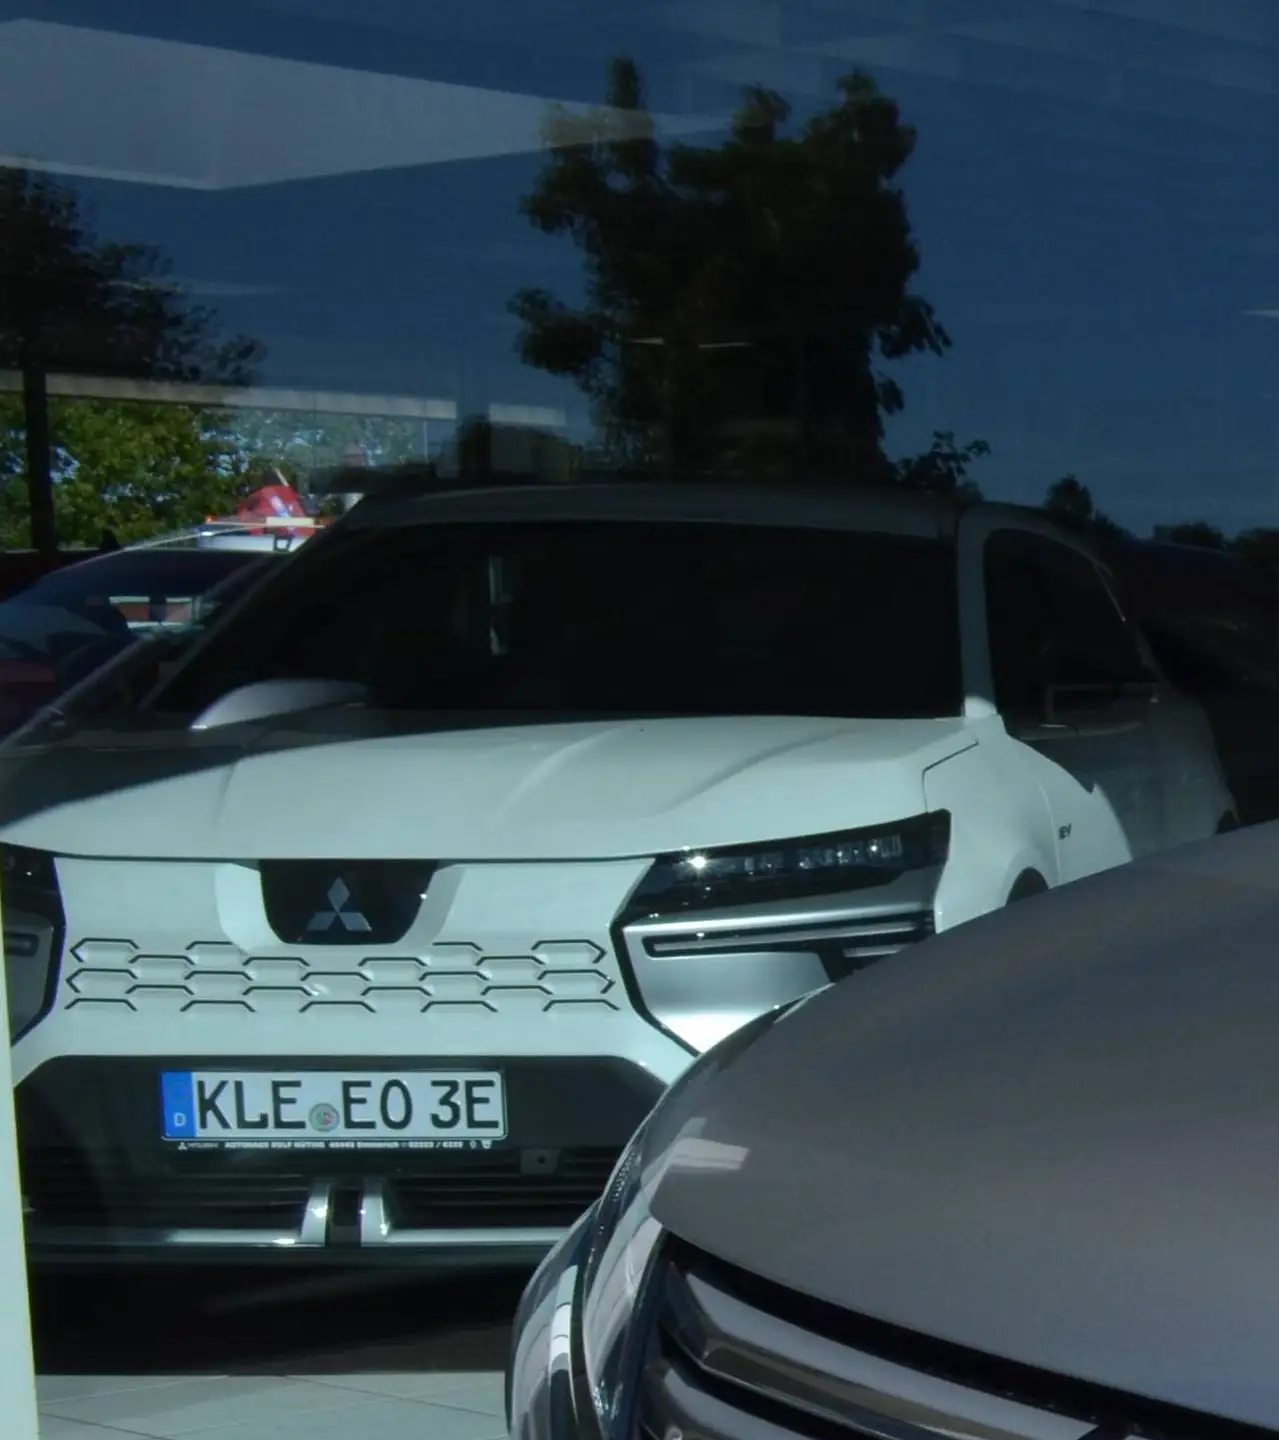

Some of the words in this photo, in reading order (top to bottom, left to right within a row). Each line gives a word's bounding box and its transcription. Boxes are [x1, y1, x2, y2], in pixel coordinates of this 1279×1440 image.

[196, 1079, 307, 1130] KLE
[340, 1078, 413, 1130] EO
[429, 1079, 500, 1130] 3E
